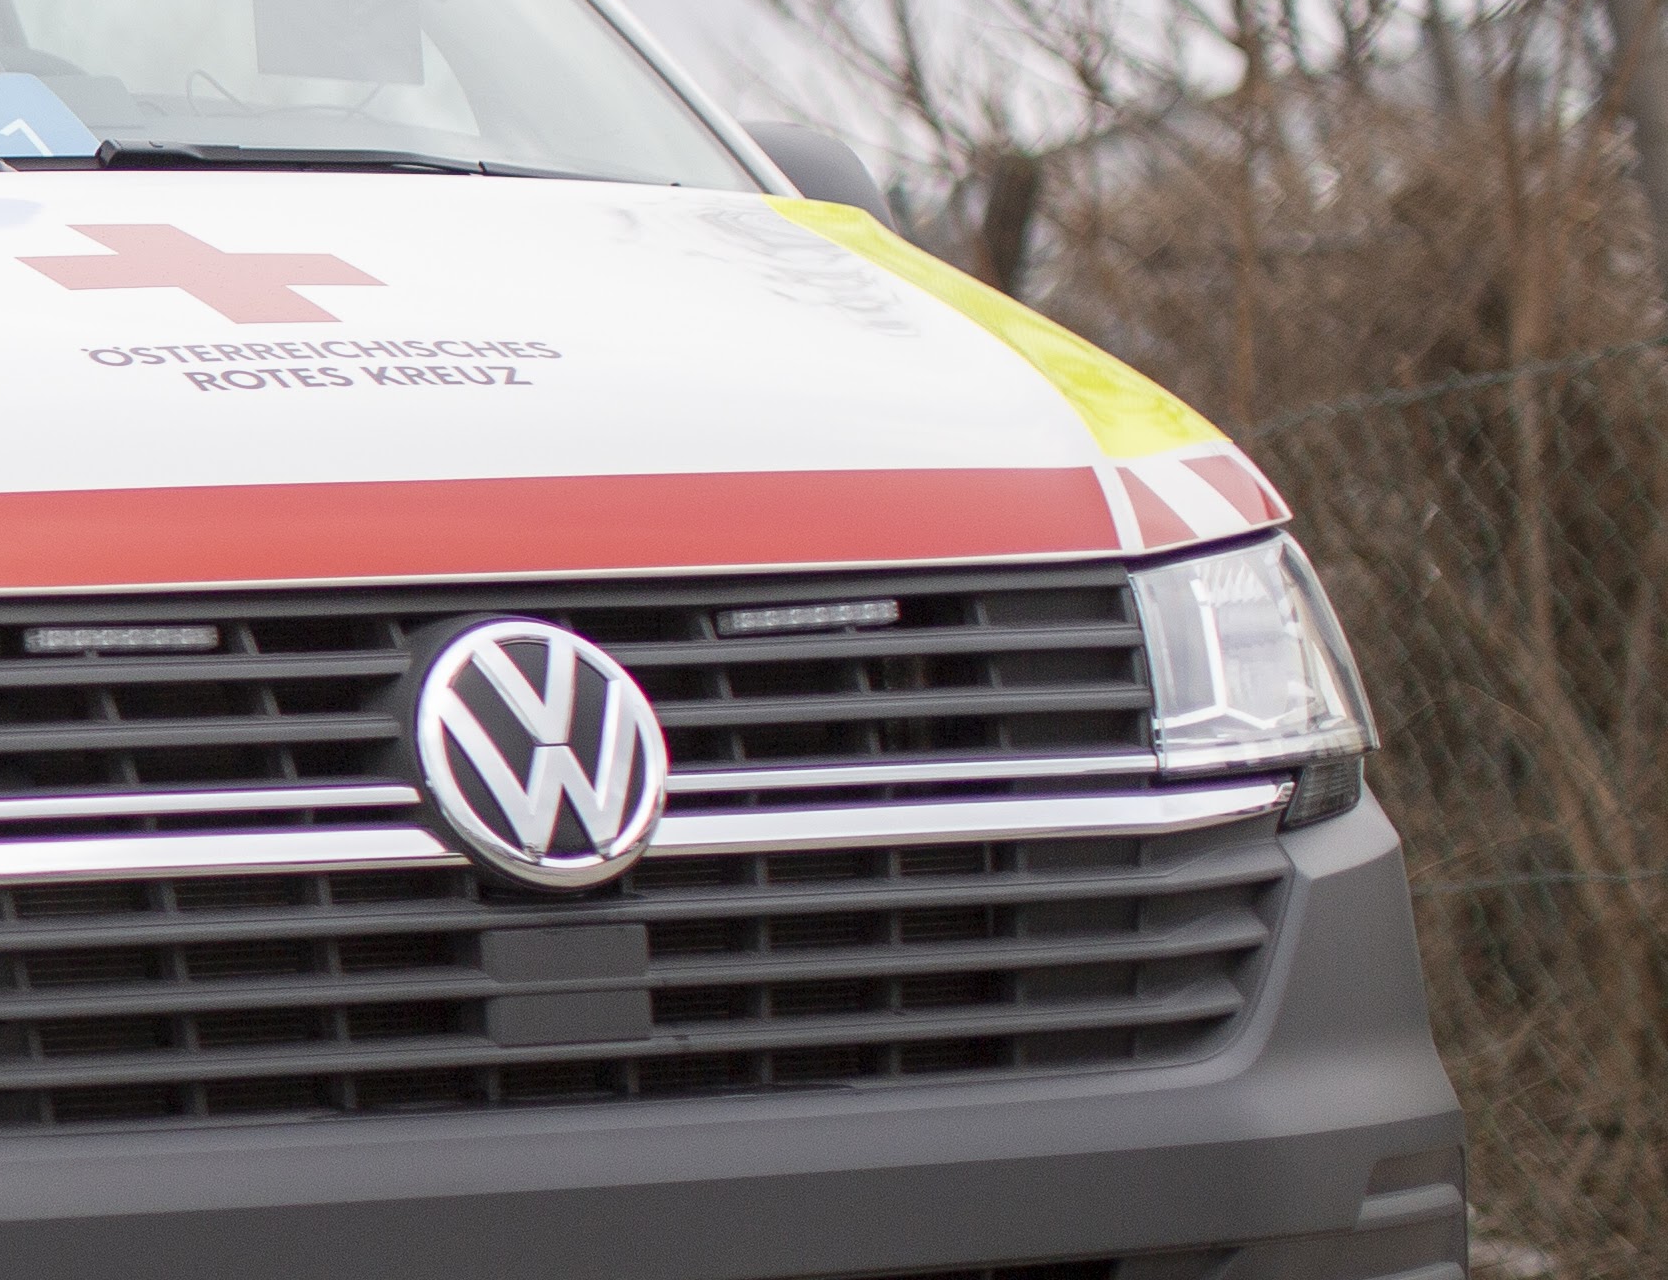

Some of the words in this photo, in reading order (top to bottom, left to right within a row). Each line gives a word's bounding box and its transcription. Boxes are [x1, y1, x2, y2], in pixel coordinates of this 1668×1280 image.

[80, 339, 564, 368] ÖSTERREICHISCHES
[182, 365, 355, 393] ROTES
[357, 364, 533, 387] KREUZ
